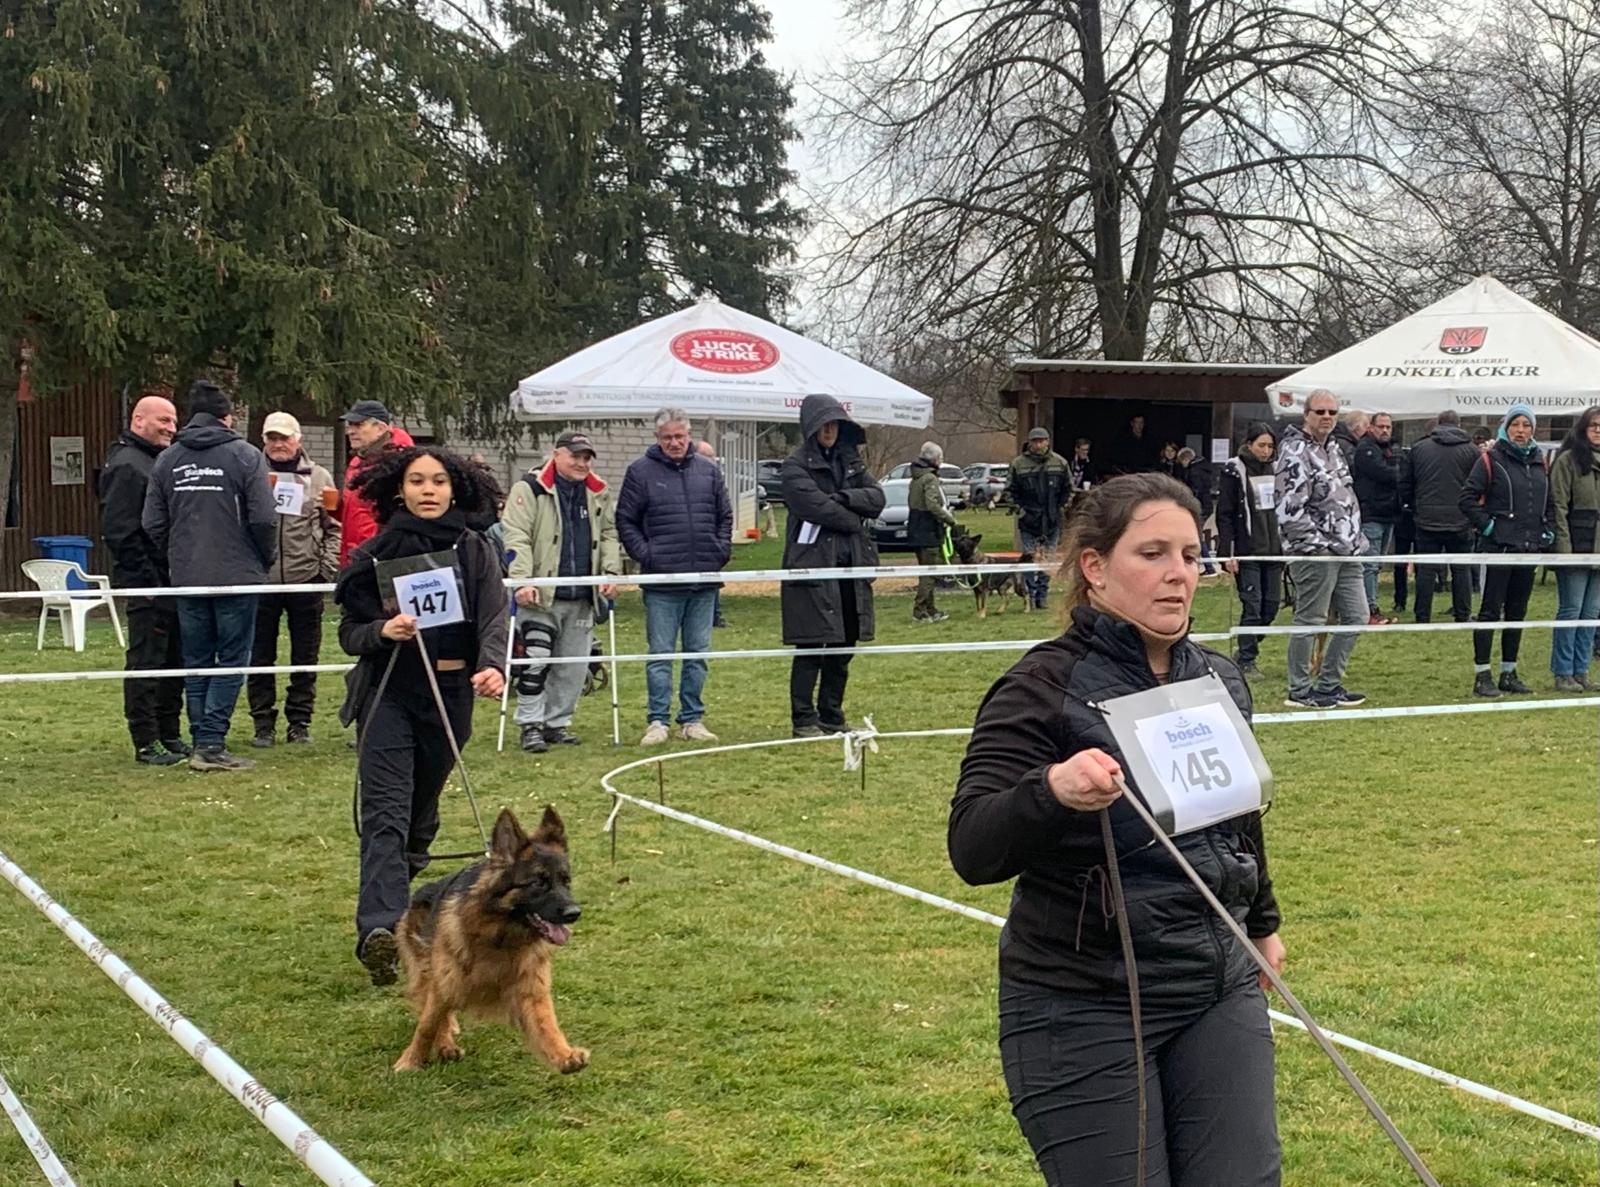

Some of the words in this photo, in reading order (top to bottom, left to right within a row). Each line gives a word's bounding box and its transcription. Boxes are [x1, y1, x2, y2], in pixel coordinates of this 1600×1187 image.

[691, 340, 757, 352] LUCKY
[690, 349, 762, 361] STRIKE
[1365, 366, 1541, 378] DINKELACKER
[1455, 396, 1481, 405] VON
[1483, 396, 1535, 406] GANZEM
[1538, 396, 1586, 407] HERZEN
[411, 579, 441, 590] bosch
[409, 590, 448, 617] 147
[1165, 723, 1213, 743] bosch
[1171, 747, 1232, 793] 145
